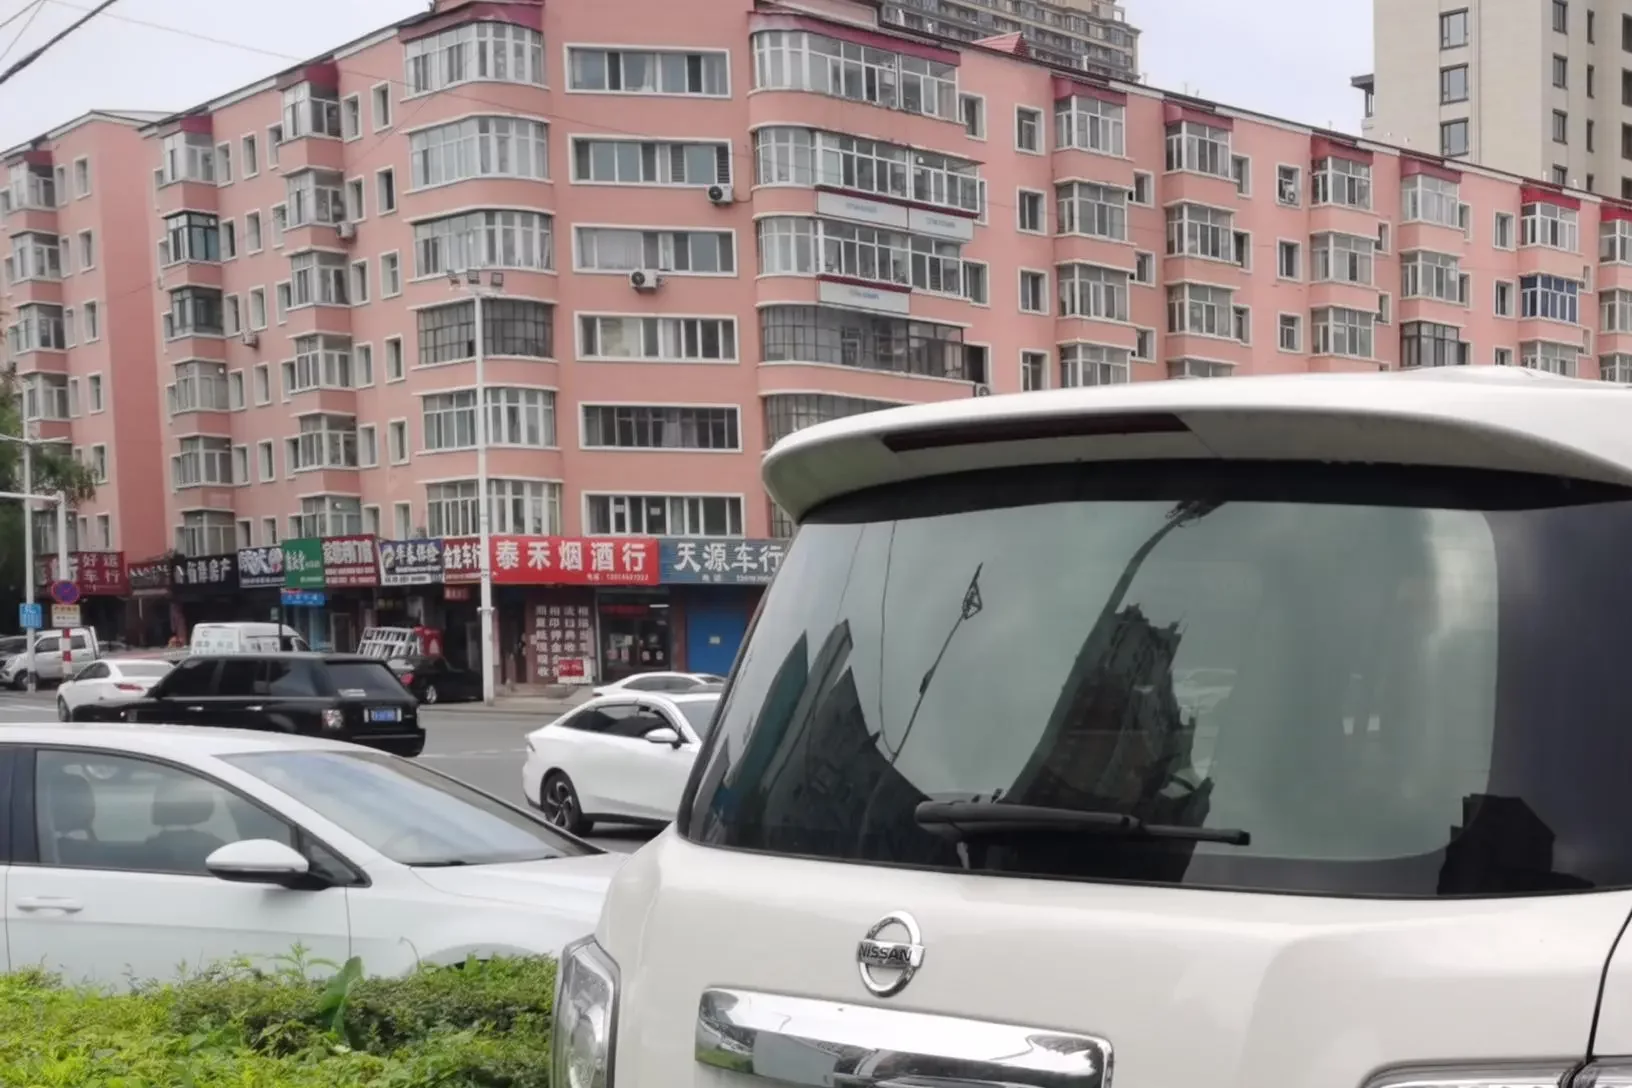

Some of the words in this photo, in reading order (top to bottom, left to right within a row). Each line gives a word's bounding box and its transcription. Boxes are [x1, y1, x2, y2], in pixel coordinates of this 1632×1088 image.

[495, 540, 646, 571] 泰禾烟酒行
[673, 541, 784, 573] 天源车行
[858, 942, 911, 962] NISSAN
